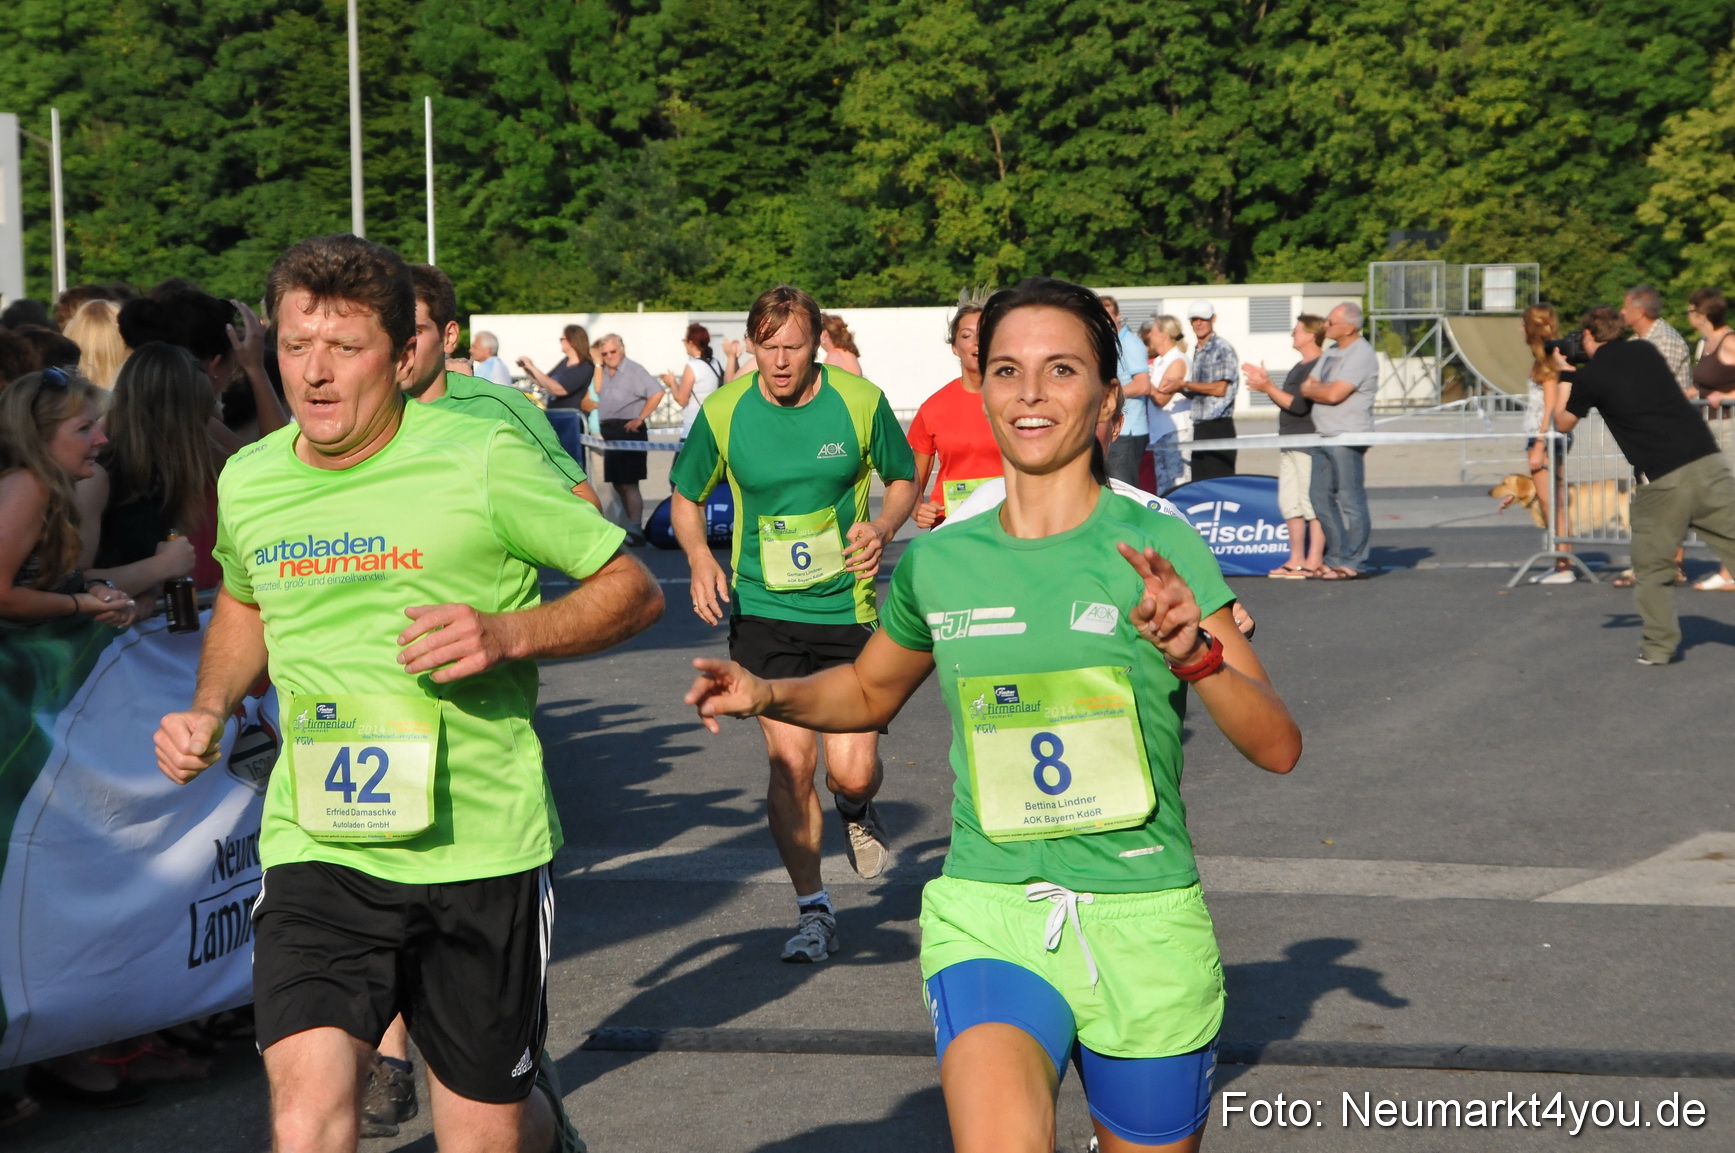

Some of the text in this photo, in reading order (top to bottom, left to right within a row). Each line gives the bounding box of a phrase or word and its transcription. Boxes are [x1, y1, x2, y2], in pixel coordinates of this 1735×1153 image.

[818, 442, 846, 456] AOK
[1195, 518, 1290, 544] Fische
[255, 532, 386, 566] autoladen
[791, 541, 812, 571] 6
[1209, 543, 1290, 555] UTOMOBIL
[279, 546, 424, 578] neumarkt
[308, 576, 326, 587] und
[1087, 606, 1116, 620] AOK
[988, 700, 1042, 714] firmenlauf
[308, 718, 357, 729] firmenlauf
[1030, 731, 1072, 796] 8
[325, 746, 391, 803] 42
[1025, 795, 1097, 811] Bettina Lindner
[326, 808, 397, 817] Erfried Damaschke
[1023, 807, 1103, 825] AOK Bayern KdöR
[332, 821, 390, 829] Autoladen GmbH
